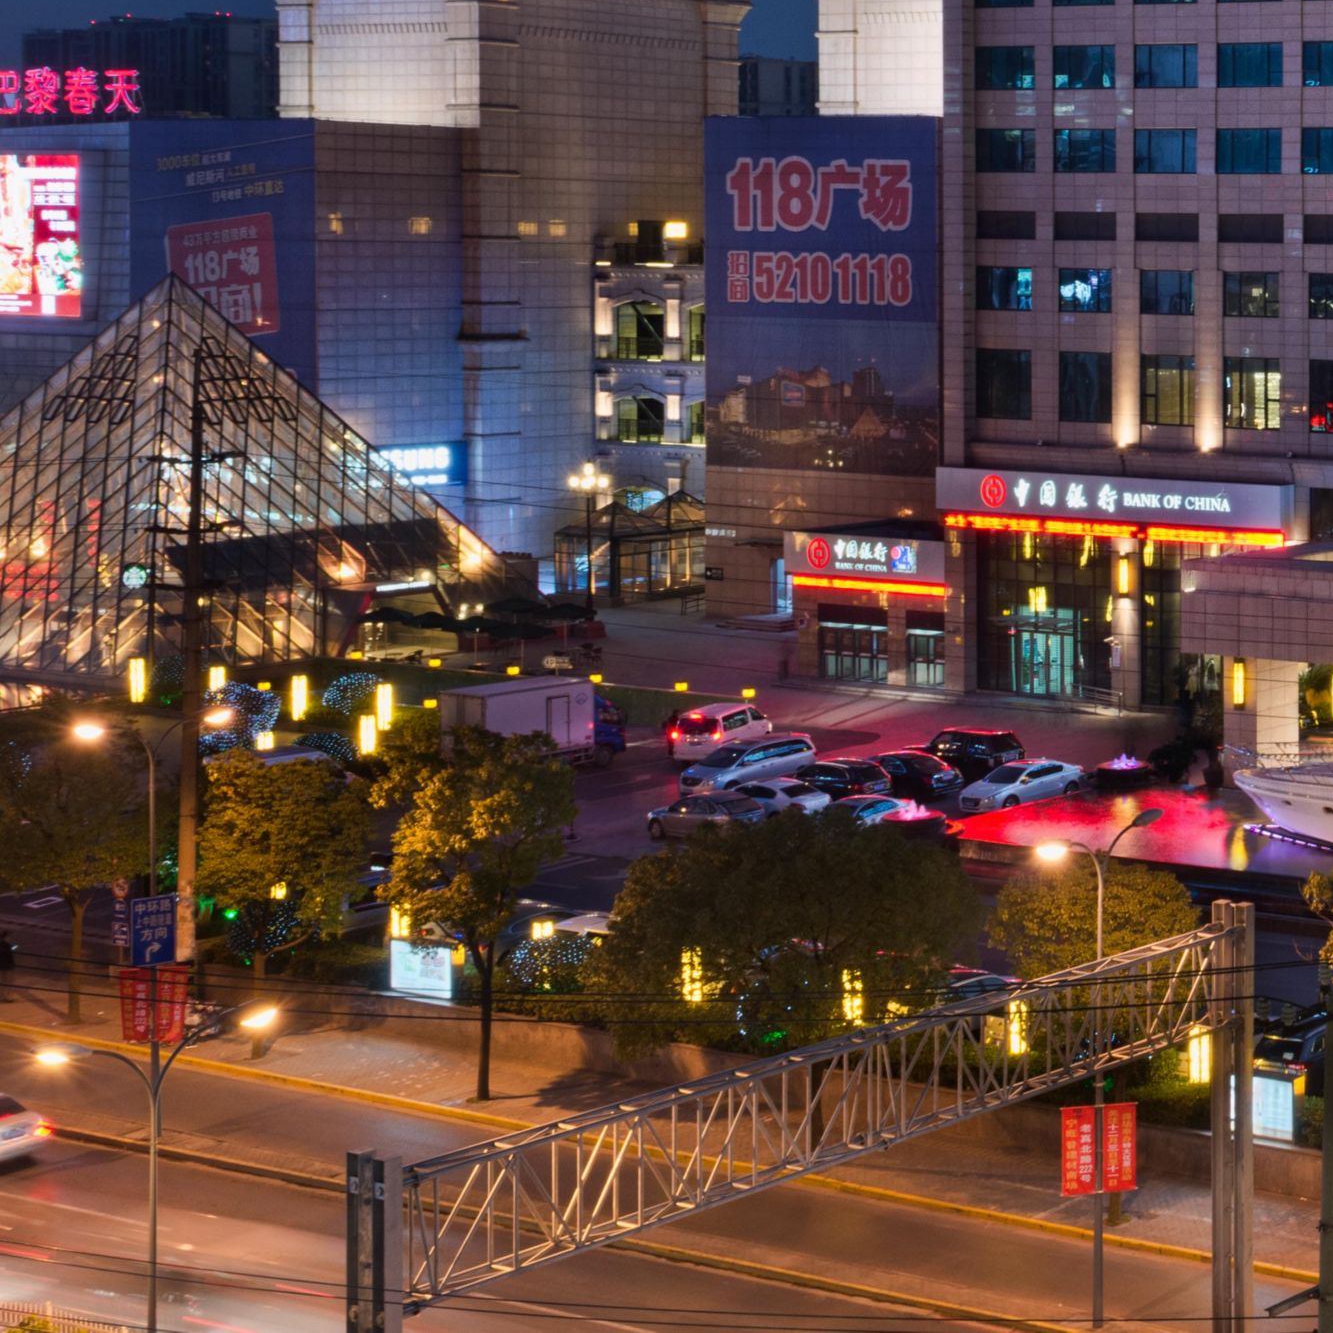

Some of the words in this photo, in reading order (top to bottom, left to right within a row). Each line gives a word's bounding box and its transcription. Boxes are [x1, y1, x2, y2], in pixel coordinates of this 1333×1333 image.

[726, 155, 912, 232] 118广场
[185, 246, 259, 284] 118广场
[1014, 478, 1118, 513] 中国银行
[1123, 492, 1161, 508] BANK
[1163, 494, 1182, 509] OF
[1185, 496, 1230, 512] CHINA
[833, 538, 889, 563] 中国银行
[835, 561, 853, 571] BANK
[855, 563, 864, 571] OF
[865, 563, 887, 573] CHINA
[140, 926, 168, 942] 方向
